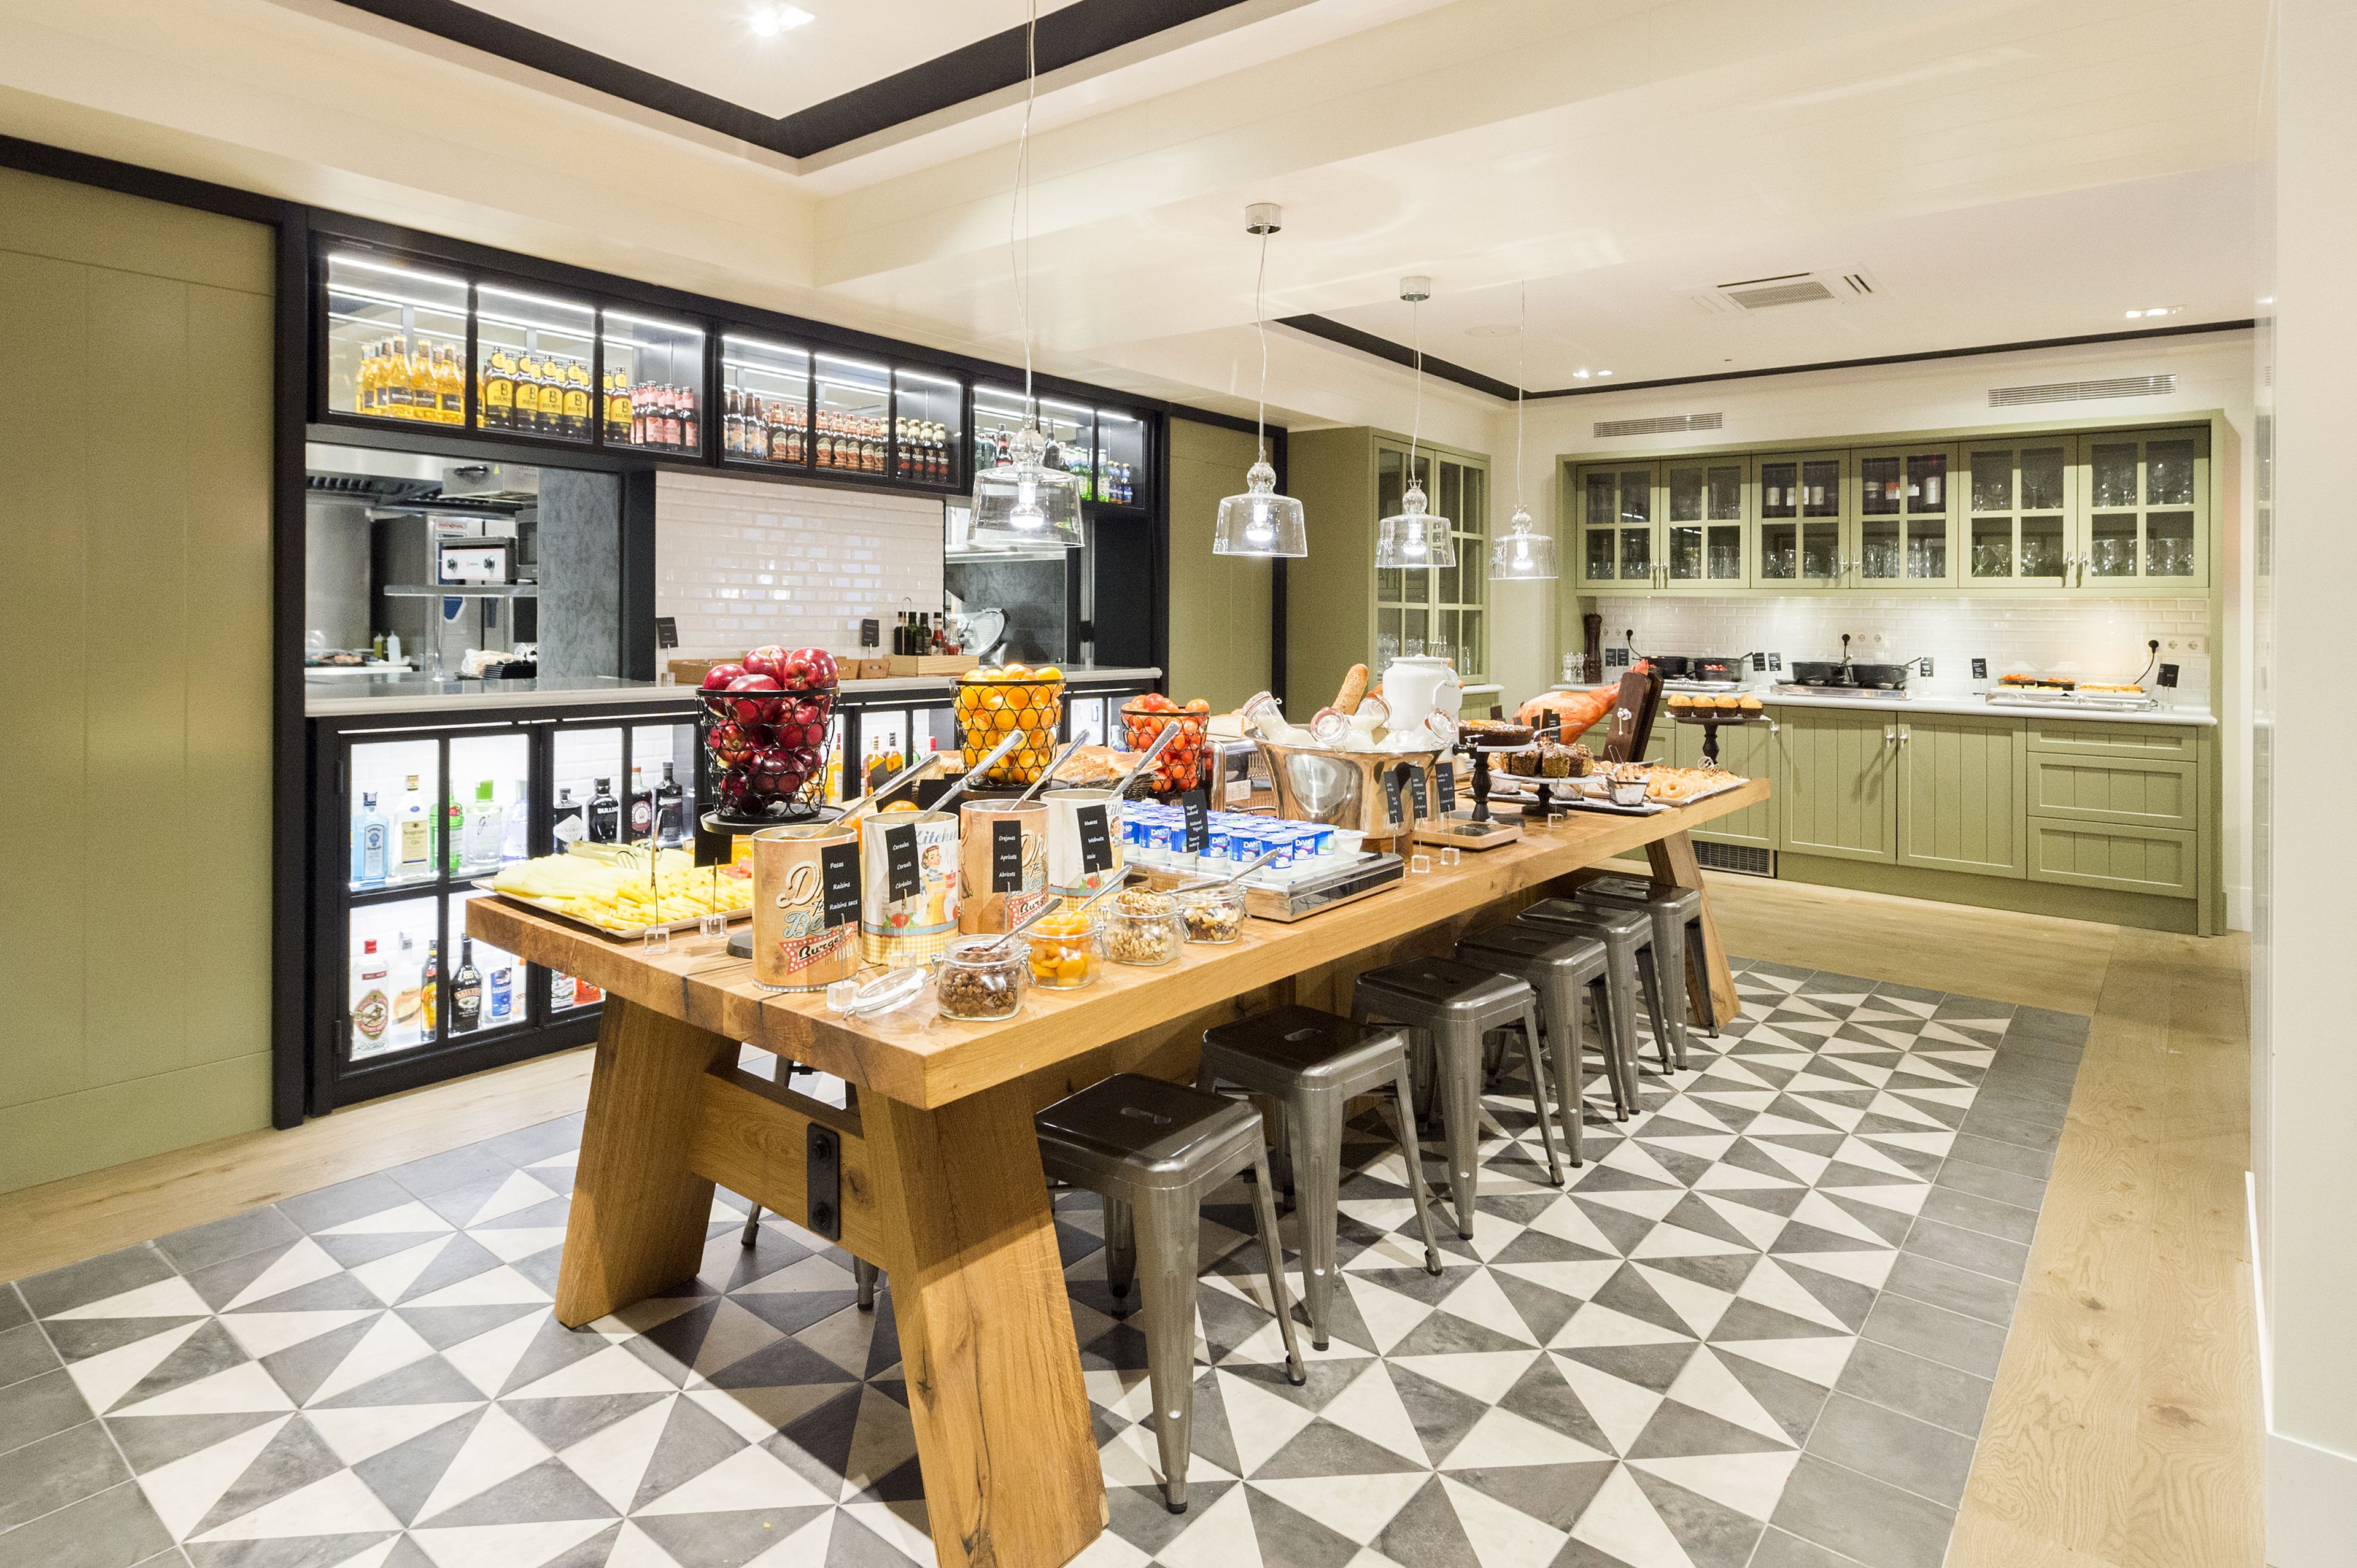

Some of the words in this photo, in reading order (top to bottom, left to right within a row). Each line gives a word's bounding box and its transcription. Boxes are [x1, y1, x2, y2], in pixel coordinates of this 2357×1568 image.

[892, 841, 909, 851] Cereales
[897, 861, 911, 870] Cereals
[829, 902, 847, 910] Raisins
[799, 937, 841, 960] Burge
